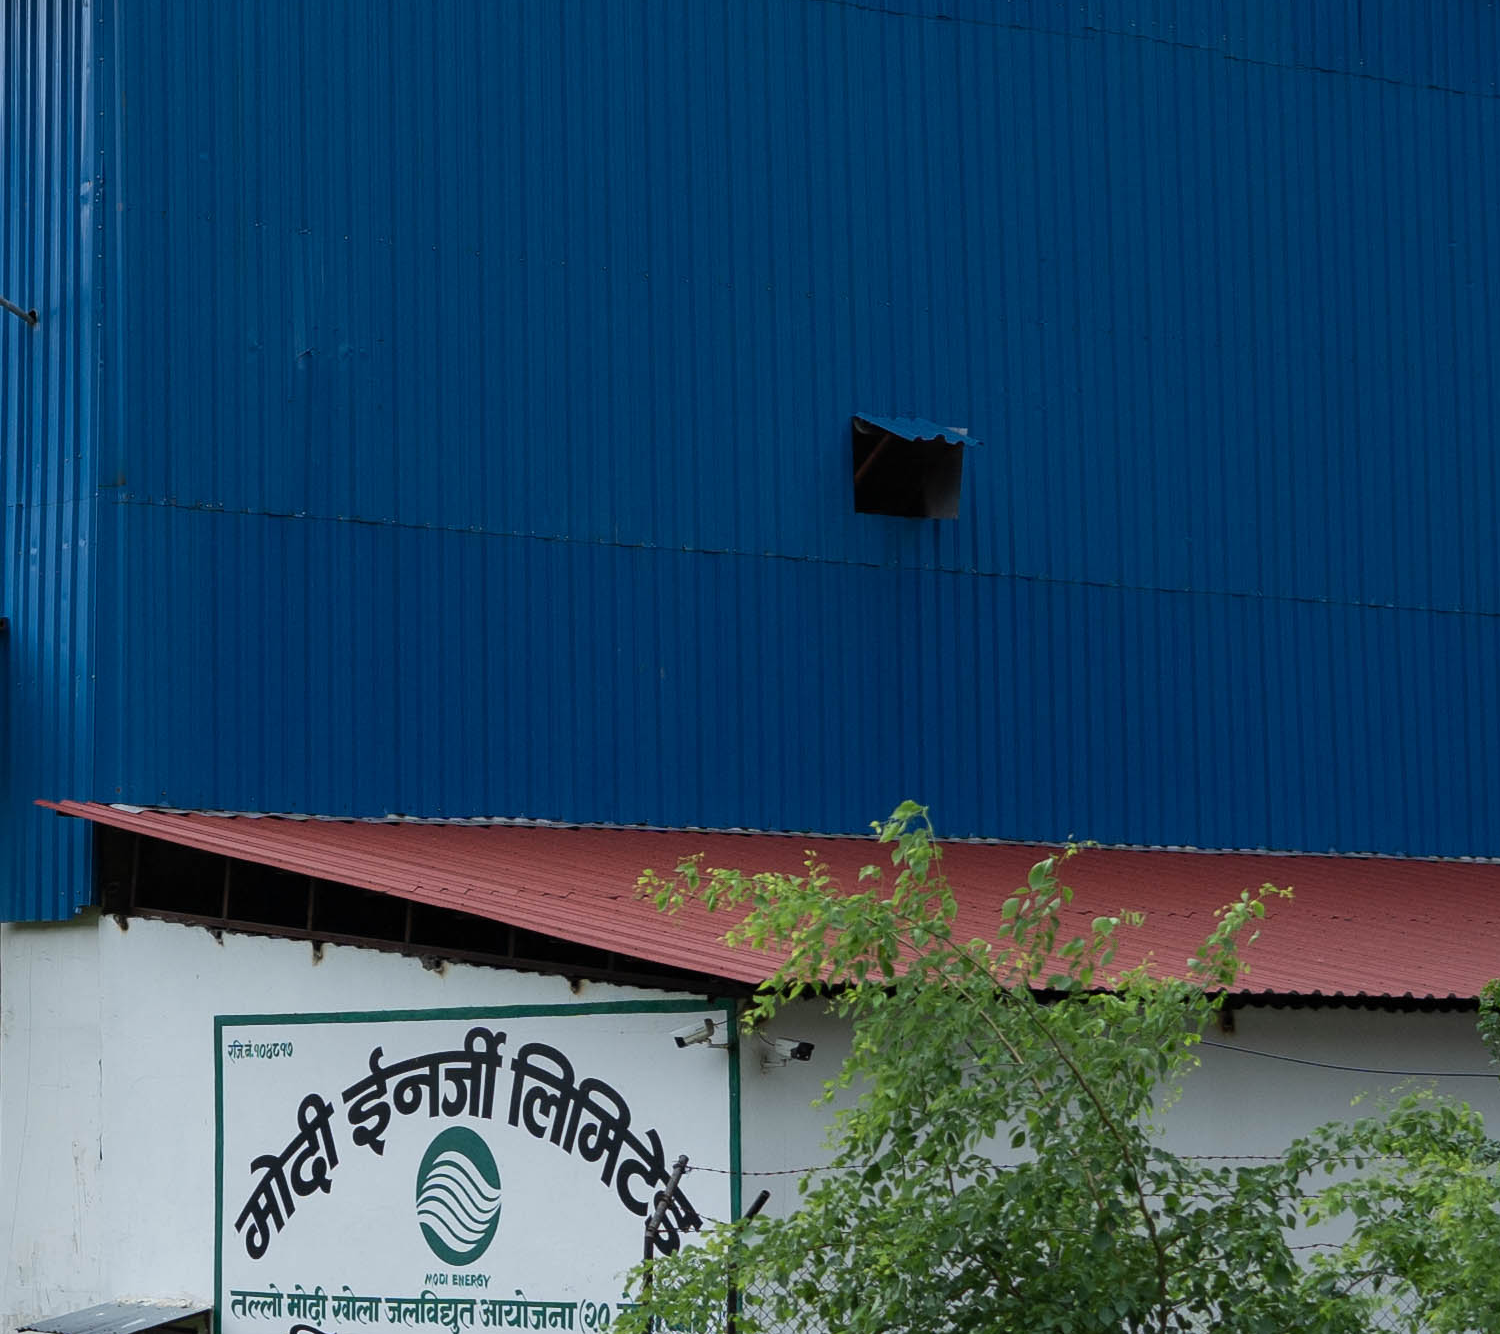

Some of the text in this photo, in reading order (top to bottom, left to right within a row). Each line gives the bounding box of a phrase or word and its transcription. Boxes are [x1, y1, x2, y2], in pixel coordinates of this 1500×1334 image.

[234, 1026, 704, 1260] मोदी ईनर्जी लिमिटेड
[424, 1273, 492, 1289] MODI ENERGY
[230, 1283, 284, 1320] तल्लो
[287, 1284, 328, 1327] मोदी
[332, 1285, 382, 1325] खोला
[479, 1289, 578, 1331] आयोजना
